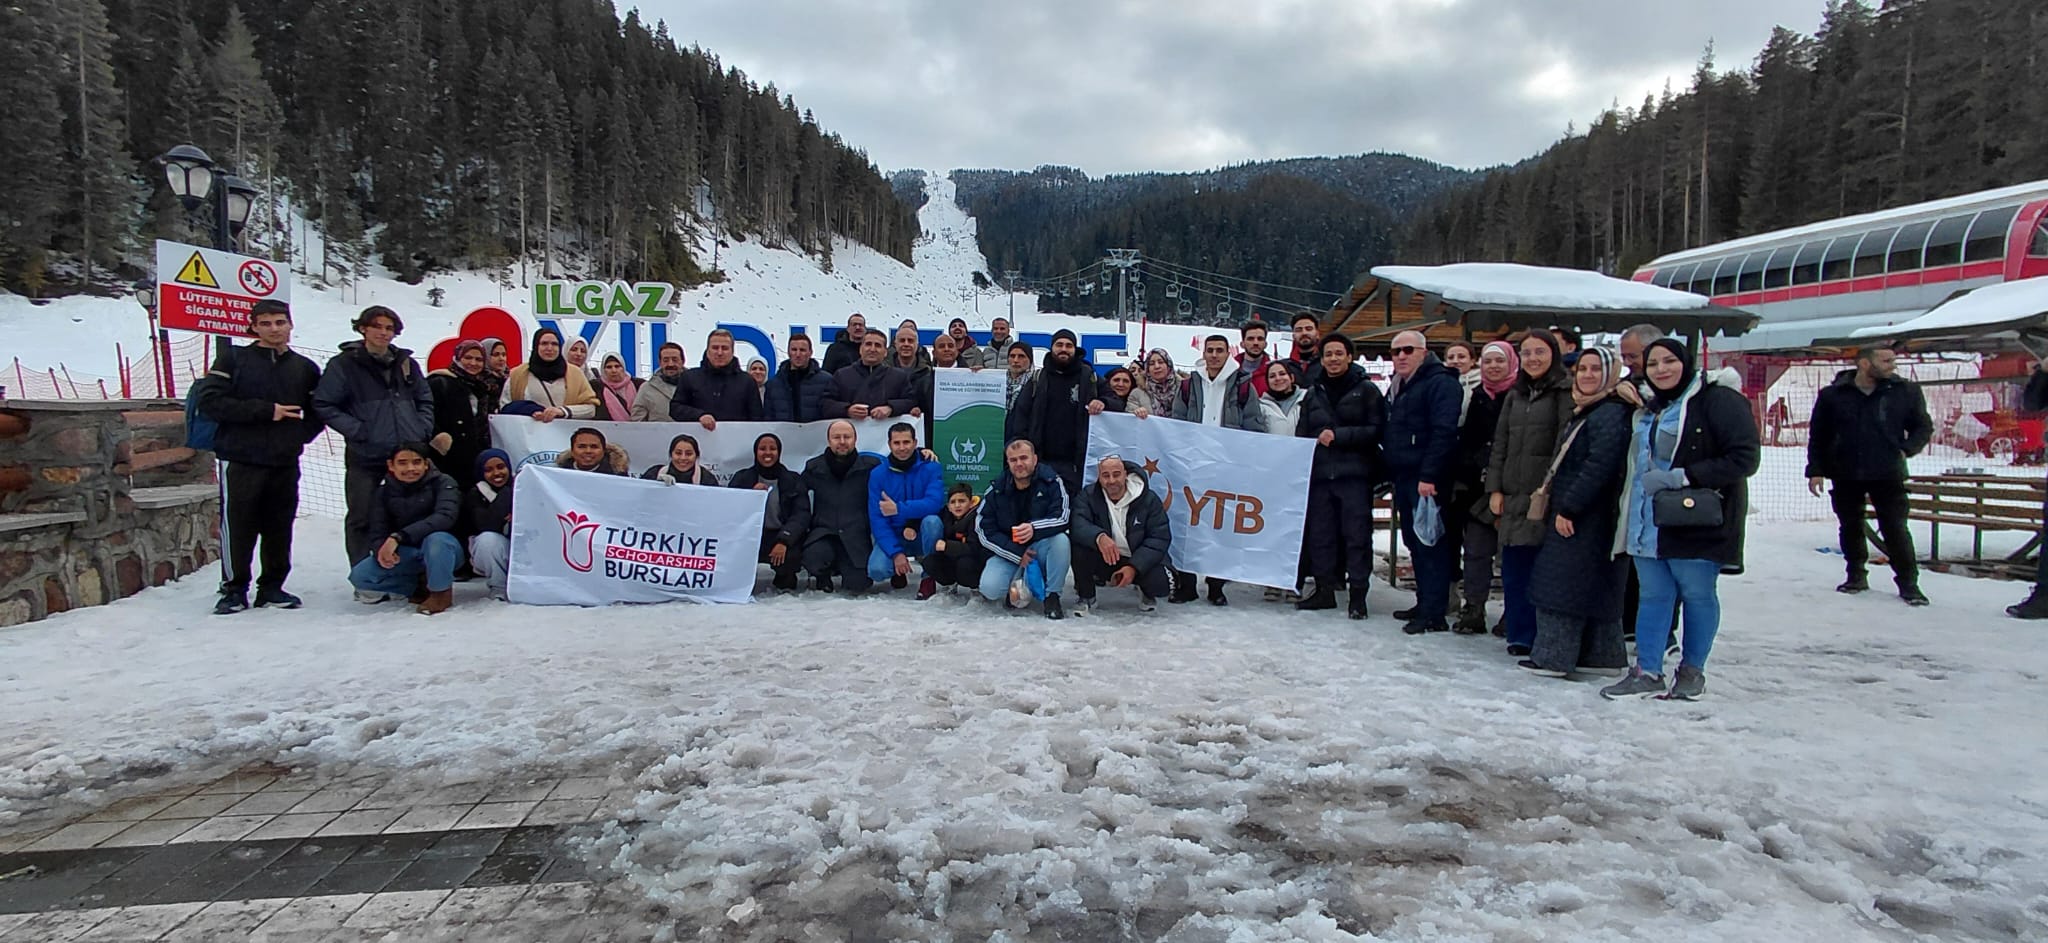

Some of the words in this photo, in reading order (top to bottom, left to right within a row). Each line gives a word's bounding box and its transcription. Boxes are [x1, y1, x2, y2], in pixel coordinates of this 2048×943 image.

[179, 291, 223, 306] LÜTFEN
[227, 298, 256, 310] YERL
[185, 304, 227, 319] SİGARA
[230, 311, 244, 321] VE
[536, 284, 670, 317] ILGAZ
[198, 320, 250, 333] ATMAYIN
[1184, 486, 1265, 534] YTB
[606, 527, 718, 557] TÜRKİYE
[607, 547, 714, 570] SCHOLARSHIPS
[605, 560, 714, 588] BURSLARI
